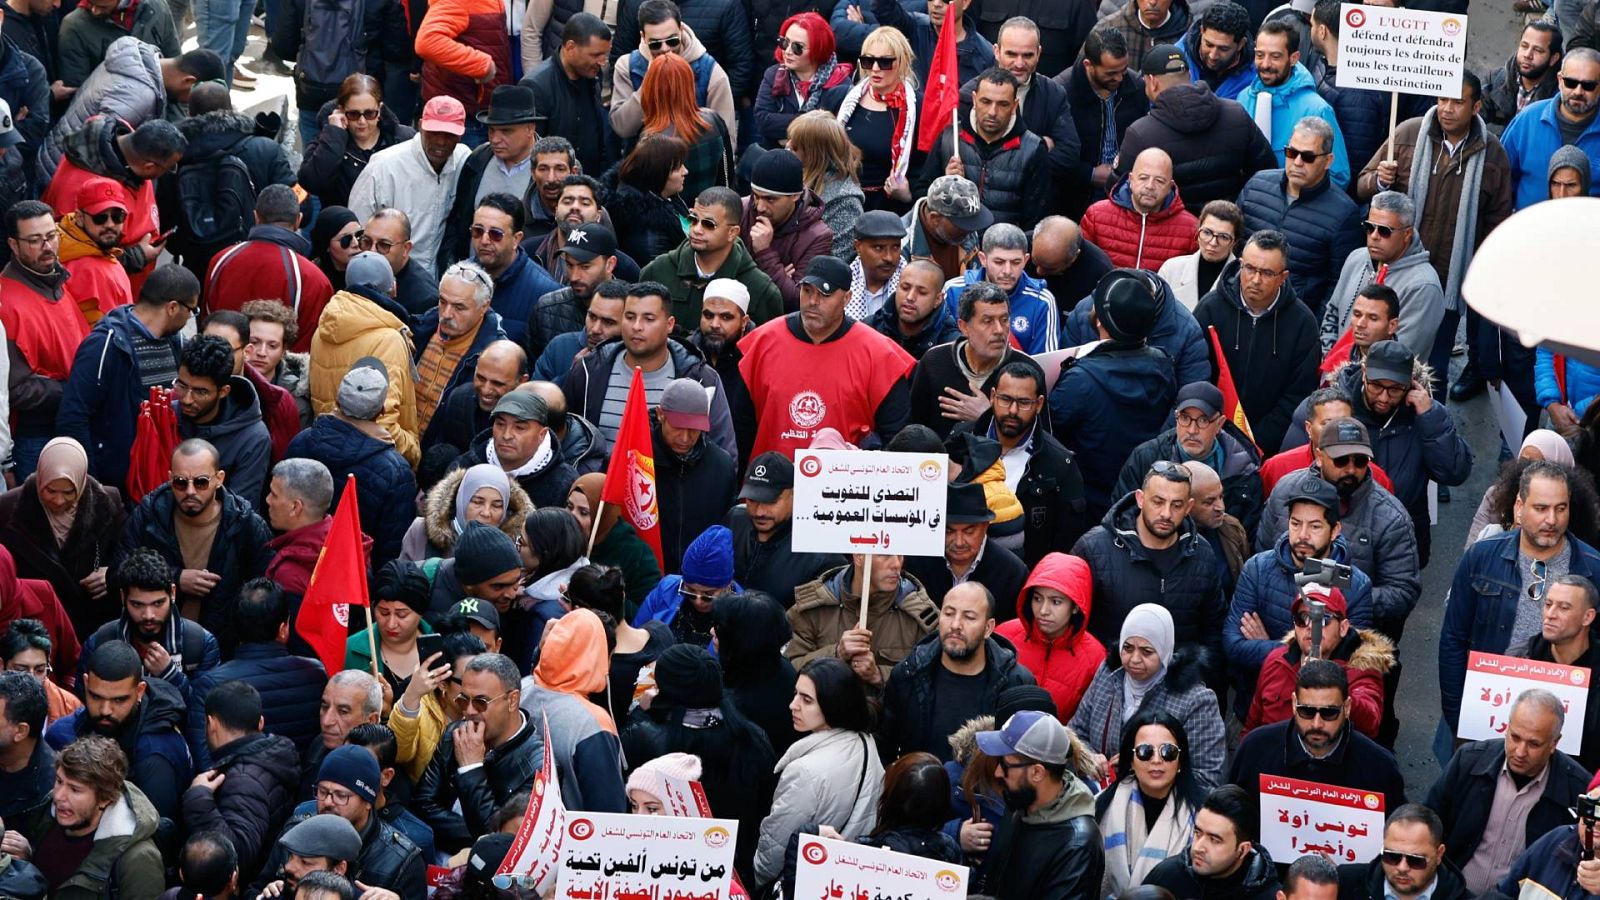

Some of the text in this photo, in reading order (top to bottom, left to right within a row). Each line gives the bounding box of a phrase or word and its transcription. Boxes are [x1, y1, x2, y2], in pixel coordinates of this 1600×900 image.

[1352, 30, 1454, 48] défend et défendra
[1346, 45, 1461, 64] toujours les droits de
[1347, 60, 1454, 78] tous les travailleurs
[1356, 76, 1442, 90] sans distinction
[822, 484, 870, 503] للتفويت
[813, 505, 869, 525] العمومية
[872, 508, 926, 528] المؤسسات
[928, 508, 941, 532] في
[850, 530, 890, 548] واجب
[1322, 790, 1338, 799] العام
[1278, 809, 1368, 838] تونس أولا
[604, 848, 647, 877] ألفين
[650, 856, 697, 880] تونس
[700, 863, 726, 882] من
